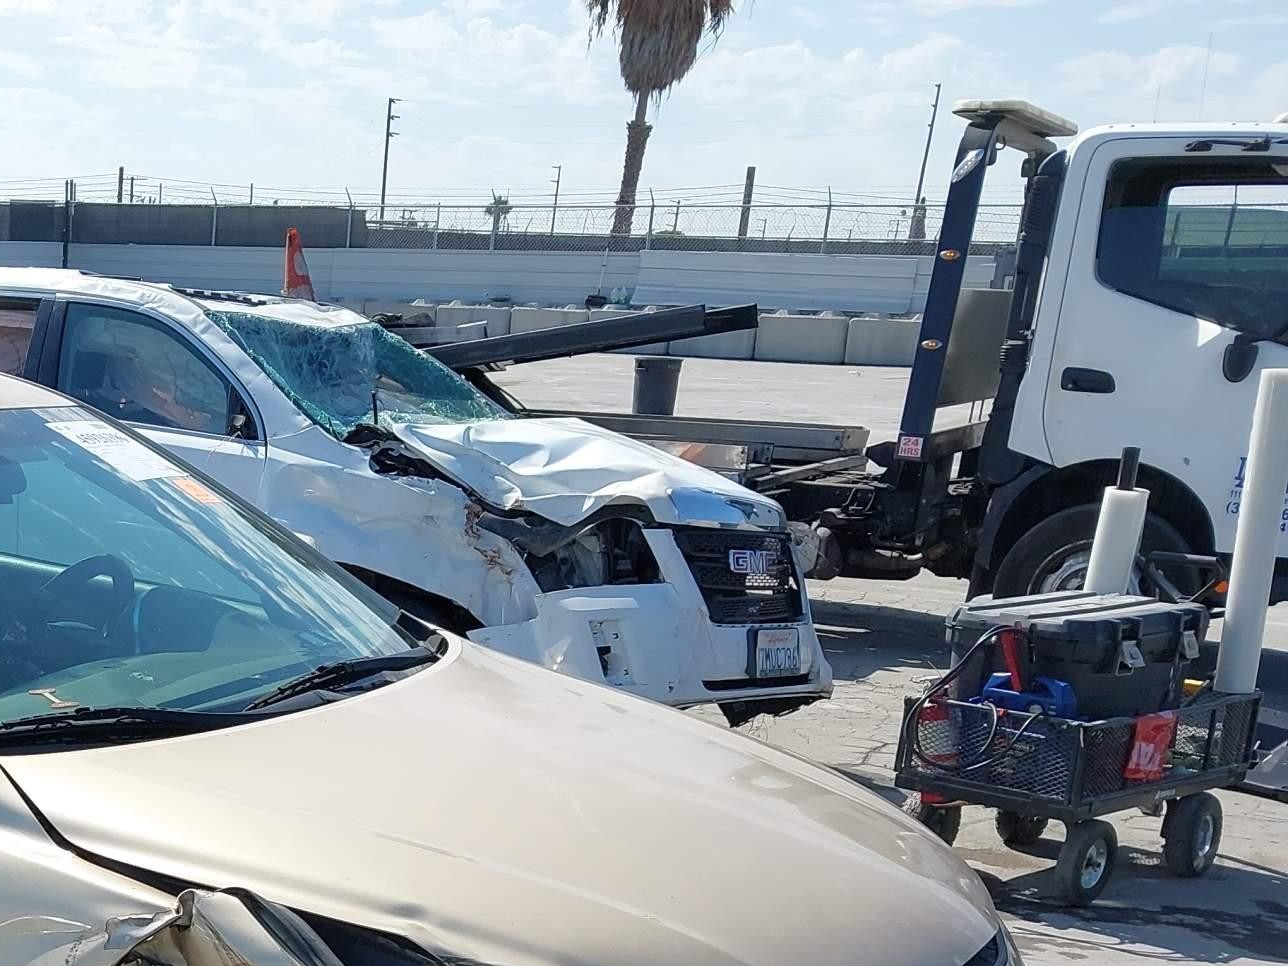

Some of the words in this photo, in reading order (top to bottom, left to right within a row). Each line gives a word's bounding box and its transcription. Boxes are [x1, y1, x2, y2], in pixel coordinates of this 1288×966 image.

[902, 437, 919, 447] 24
[900, 447, 920, 456] HRS
[729, 549, 777, 574] GMC
